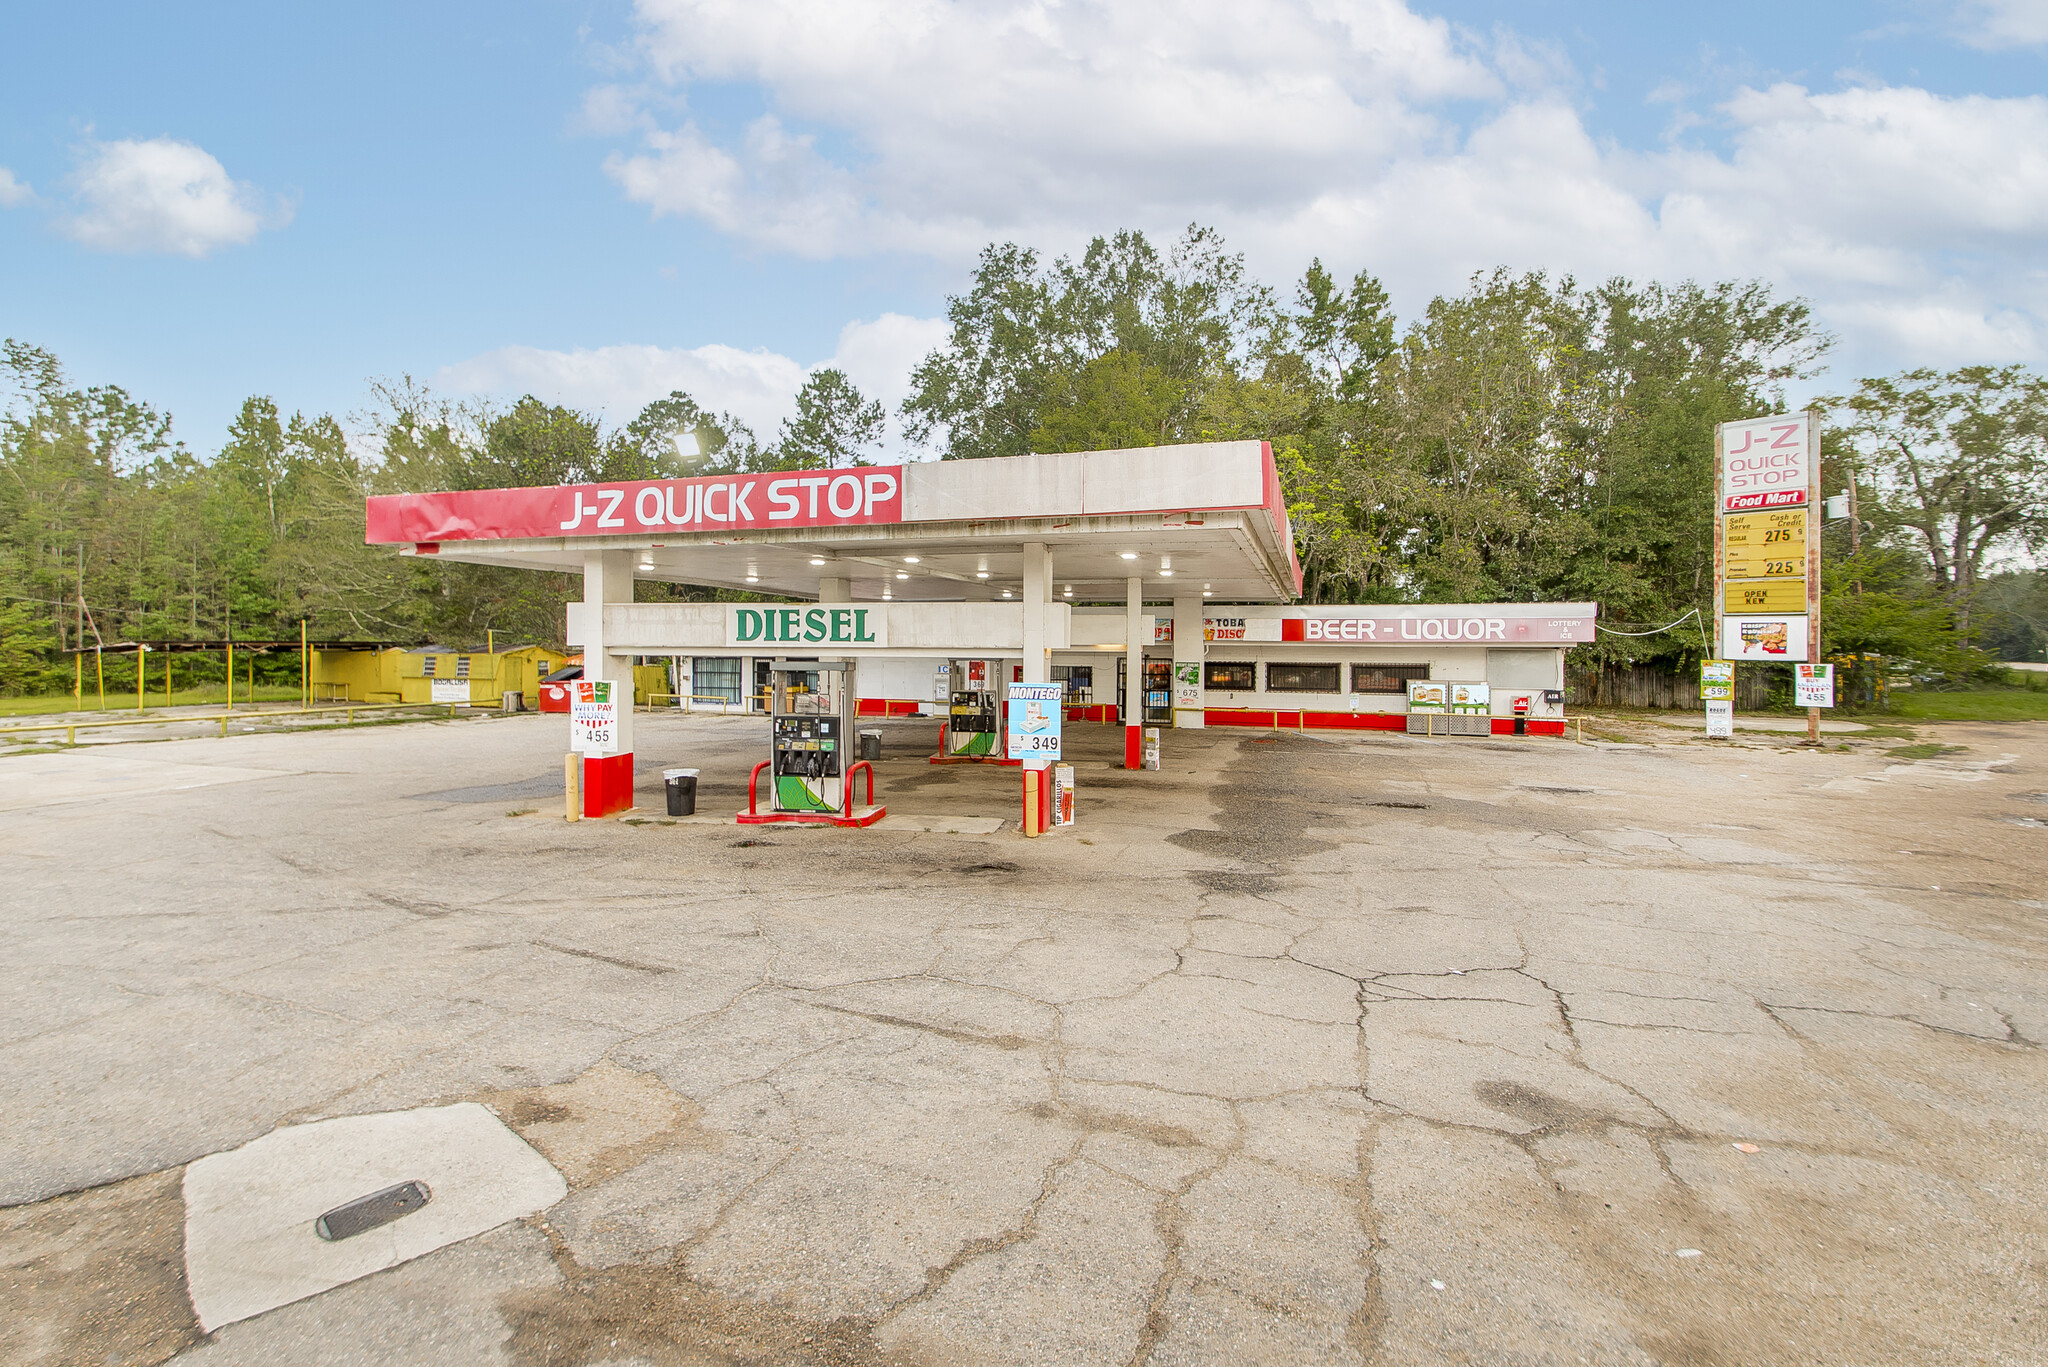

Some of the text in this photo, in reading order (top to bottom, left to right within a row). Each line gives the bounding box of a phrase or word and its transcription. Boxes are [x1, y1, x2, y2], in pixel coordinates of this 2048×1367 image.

[1730, 424, 1799, 454] J-Z
[1729, 453, 1800, 472] QUICK
[1730, 469, 1799, 488] STOP
[560, 474, 897, 530] J-Z QUICK STOP
[1731, 491, 1799, 507] Food Mart
[1729, 523, 1751, 531] Serve
[1777, 519, 1801, 527] Credit
[1765, 529, 1790, 542] 275
[1766, 561, 1793, 574] 225
[736, 609, 875, 643] DIESEL
[1216, 619, 1246, 627] TOBA
[1306, 619, 1377, 640] BEER
[1401, 618, 1506, 640] LIQUOR
[1547, 620, 1582, 628] LOTTERY
[938, 665, 949, 673] IC
[1009, 687, 1062, 700] MONTEGO
[1711, 687, 1728, 696] 599
[1806, 693, 1826, 701] 455
[577, 711, 611, 719] MORE?
[586, 730, 609, 742] 455
[1032, 737, 1058, 750] 349
